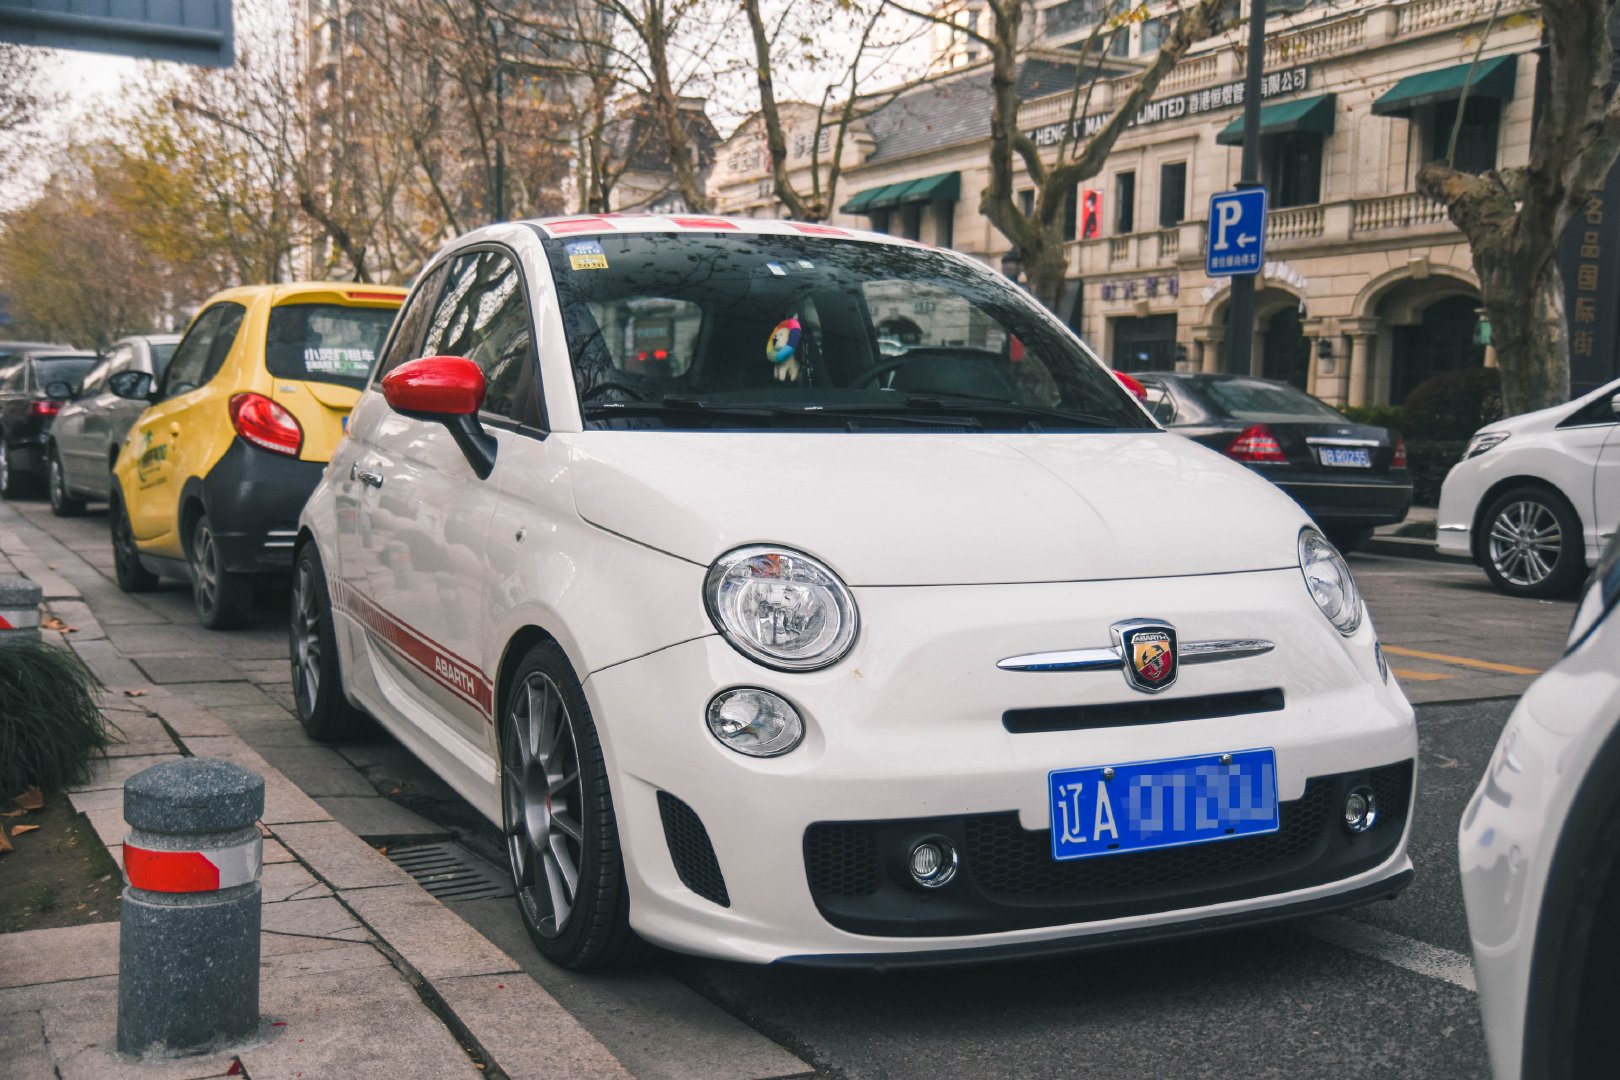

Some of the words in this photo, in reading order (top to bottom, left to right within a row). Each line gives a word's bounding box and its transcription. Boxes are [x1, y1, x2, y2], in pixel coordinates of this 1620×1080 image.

[1137, 98, 1186, 125] LIMITED
[1213, 200, 1243, 251] P
[1135, 634, 1166, 642] ABARTH
[435, 655, 475, 695] ABARTH
